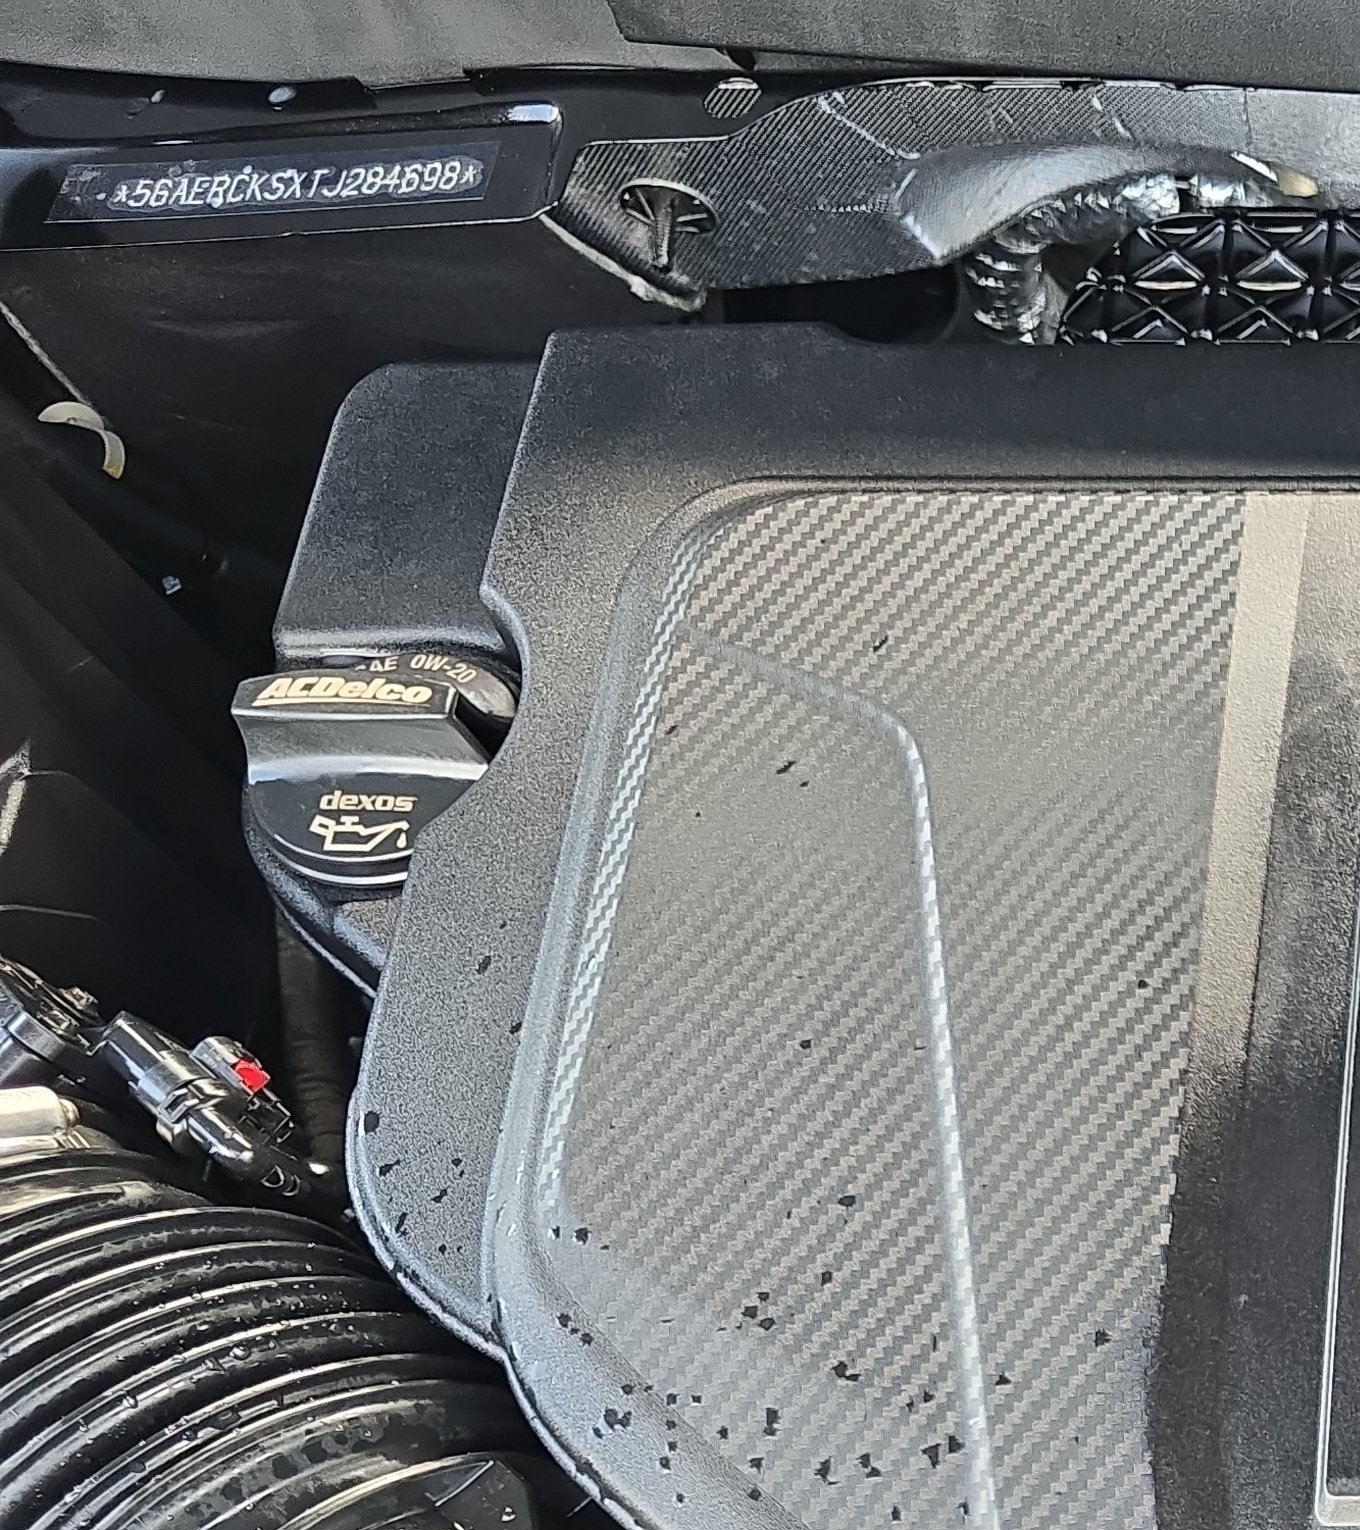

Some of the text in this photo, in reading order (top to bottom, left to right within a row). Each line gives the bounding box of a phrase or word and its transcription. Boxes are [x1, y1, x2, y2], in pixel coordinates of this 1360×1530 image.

[354, 653, 478, 683] AE 0W-20
[253, 676, 434, 706] ACDelco
[318, 789, 418, 813] dexos
